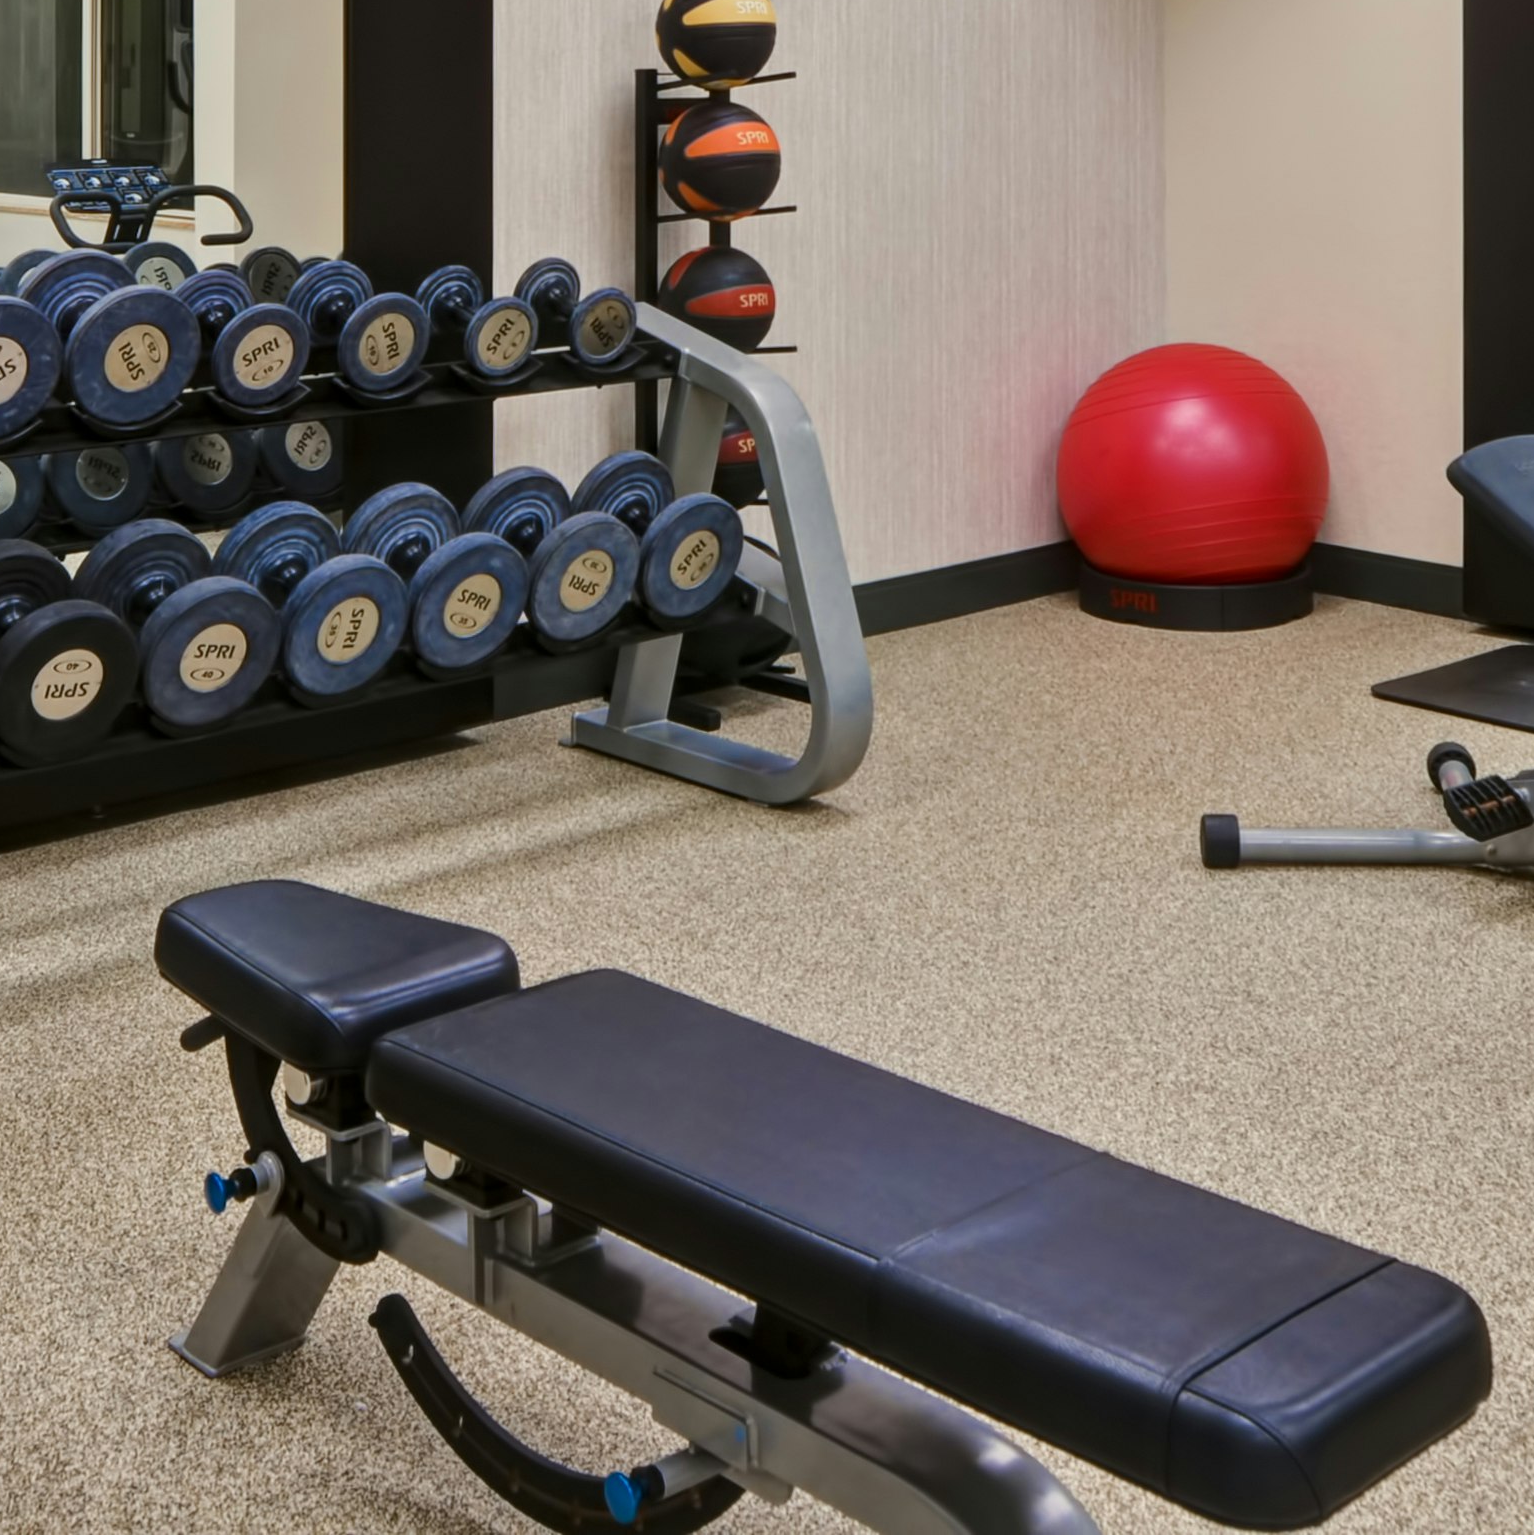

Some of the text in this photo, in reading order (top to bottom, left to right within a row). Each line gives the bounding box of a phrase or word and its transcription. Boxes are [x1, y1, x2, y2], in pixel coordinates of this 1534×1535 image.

[737, 0, 768, 15] SPRI
[737, 131, 769, 146] SPRI
[740, 293, 769, 308] SPRI
[383, 322, 401, 360] SPRI
[487, 318, 516, 355] SPRI
[118, 342, 145, 382] SPRI
[243, 337, 281, 368] SPRI
[263, 365, 274, 376] 10
[738, 438, 755, 454] SP
[677, 539, 708, 575] SPRI
[568, 574, 600, 597] SPRI
[457, 588, 492, 612] SPRI
[1109, 588, 1158, 613] SPRI
[342, 608, 365, 650] SPRI
[193, 644, 236, 661] SPRI
[200, 669, 214, 679] 40
[43, 682, 90, 700] SPRI
